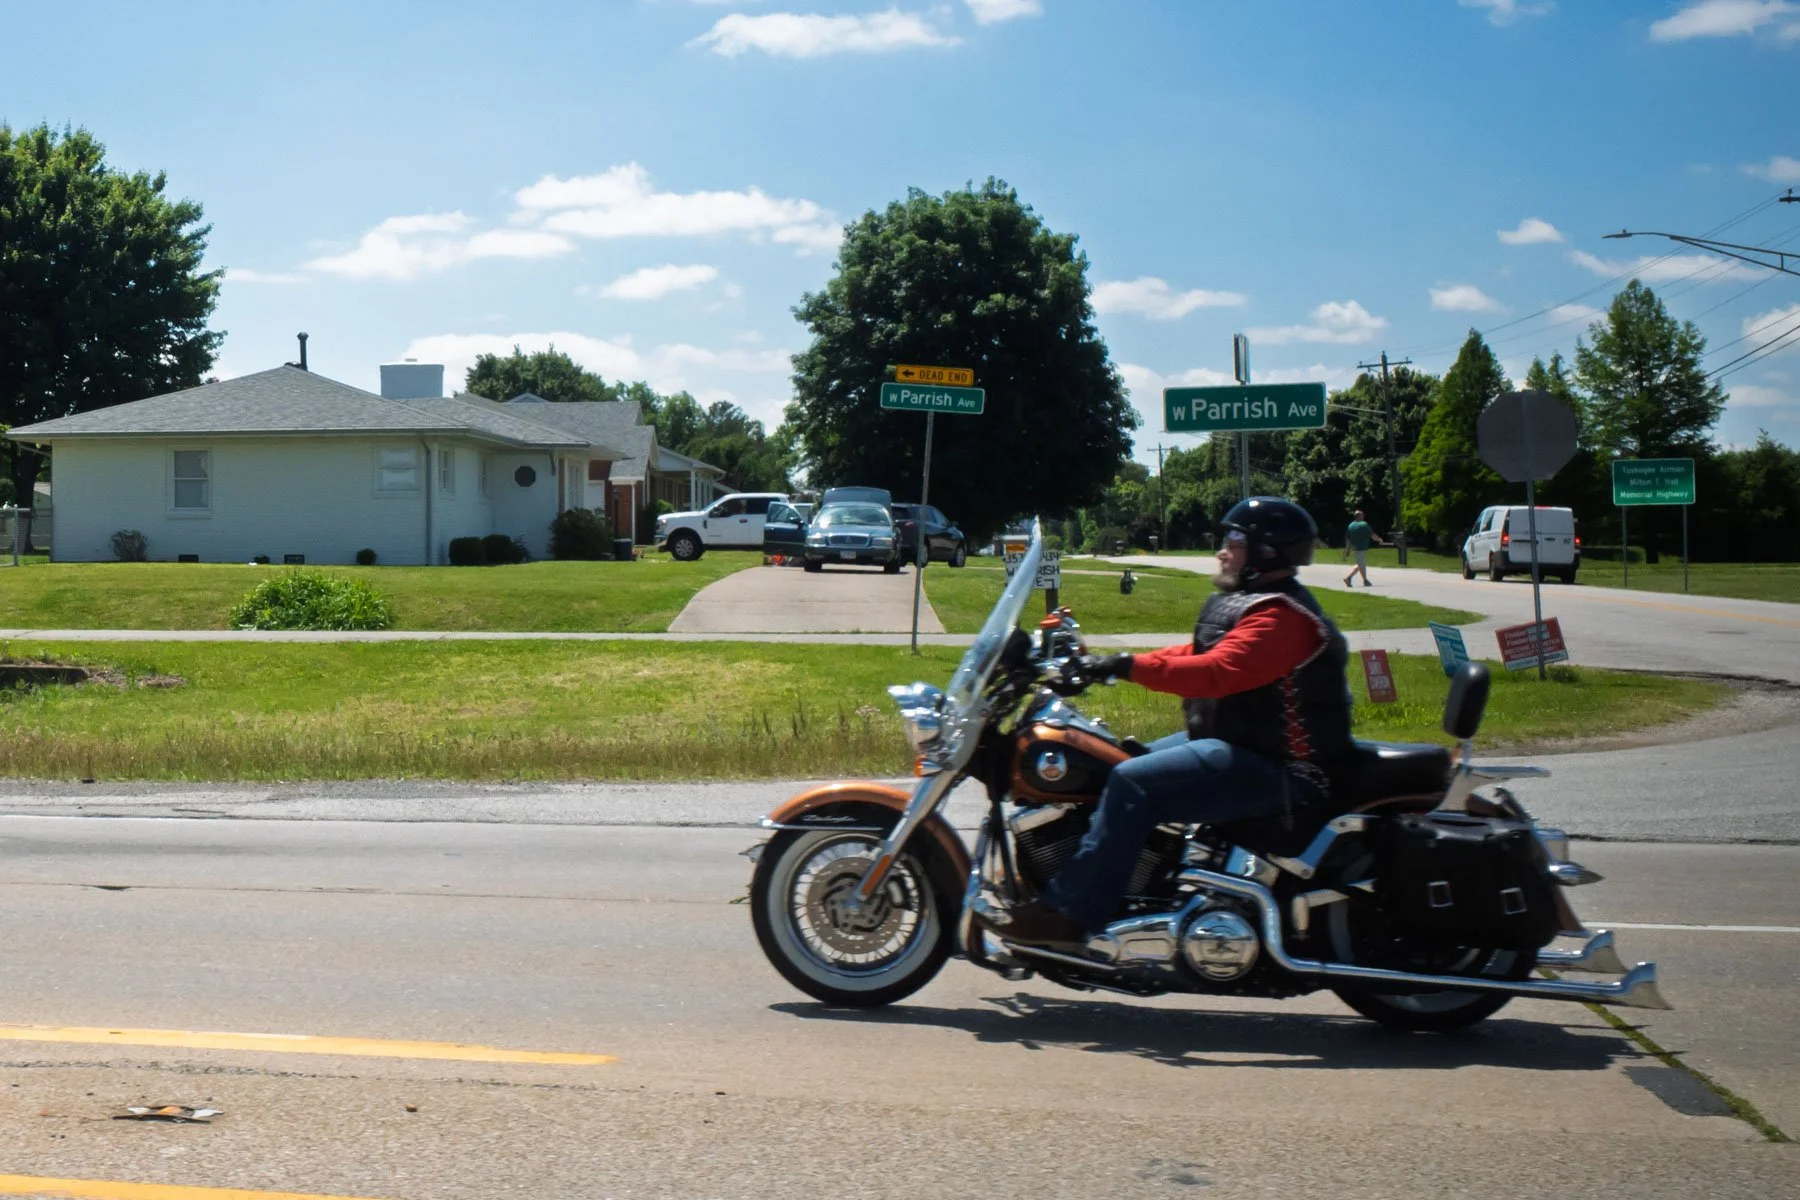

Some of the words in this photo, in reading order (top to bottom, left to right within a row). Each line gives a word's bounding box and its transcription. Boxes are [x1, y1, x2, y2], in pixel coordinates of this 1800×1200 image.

[919, 370, 944, 381] DEAD
[948, 372, 967, 382] END
[889, 392, 898, 402] W
[901, 389, 952, 406] Parrish
[957, 398, 975, 408] Ave
[1172, 405, 1186, 421] W
[1191, 397, 1278, 421] Parrish
[1288, 402, 1317, 417] Ave
[1656, 490, 1688, 499] Highway
